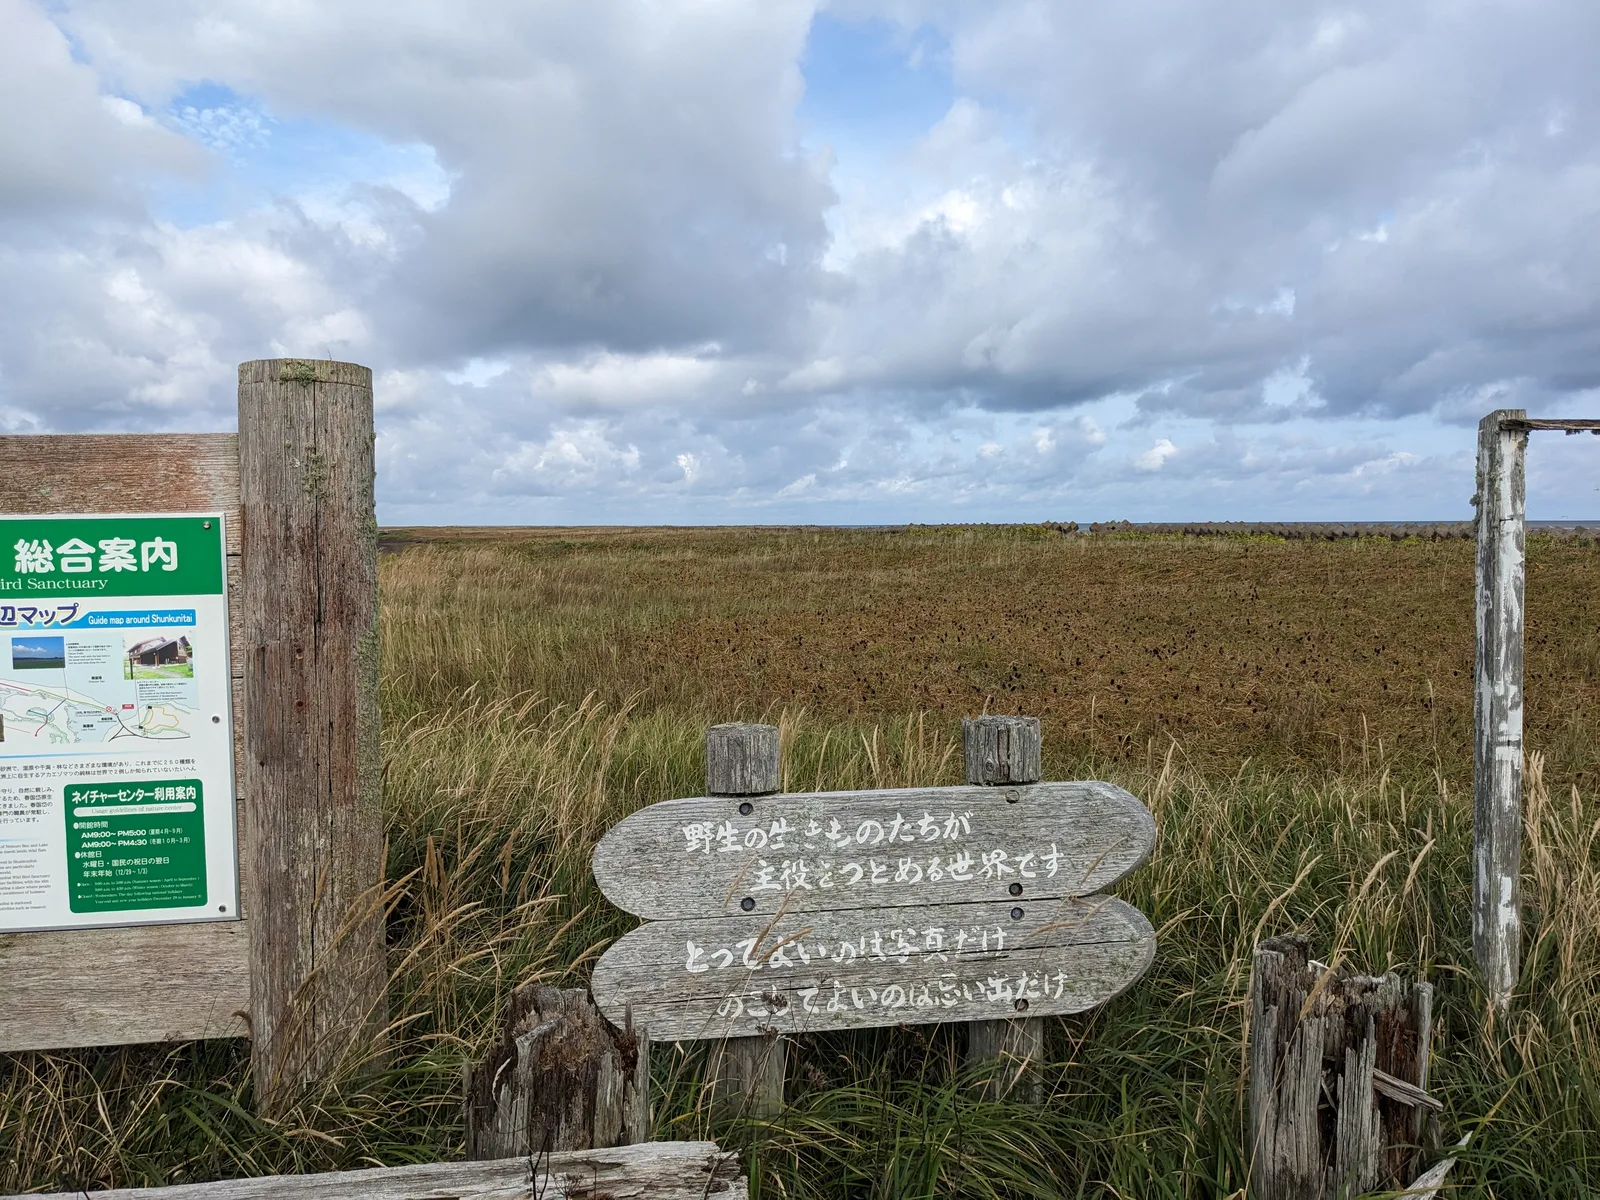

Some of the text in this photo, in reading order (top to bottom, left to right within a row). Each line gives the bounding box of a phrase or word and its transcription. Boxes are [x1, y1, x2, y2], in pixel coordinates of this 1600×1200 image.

[14, 536, 178, 574] 総合案内
[27, 577, 109, 590] Sanctuary
[88, 613, 193, 626] Guide map around Shunkunitai
[72, 785, 197, 805] ネイチャーセンター利用案内
